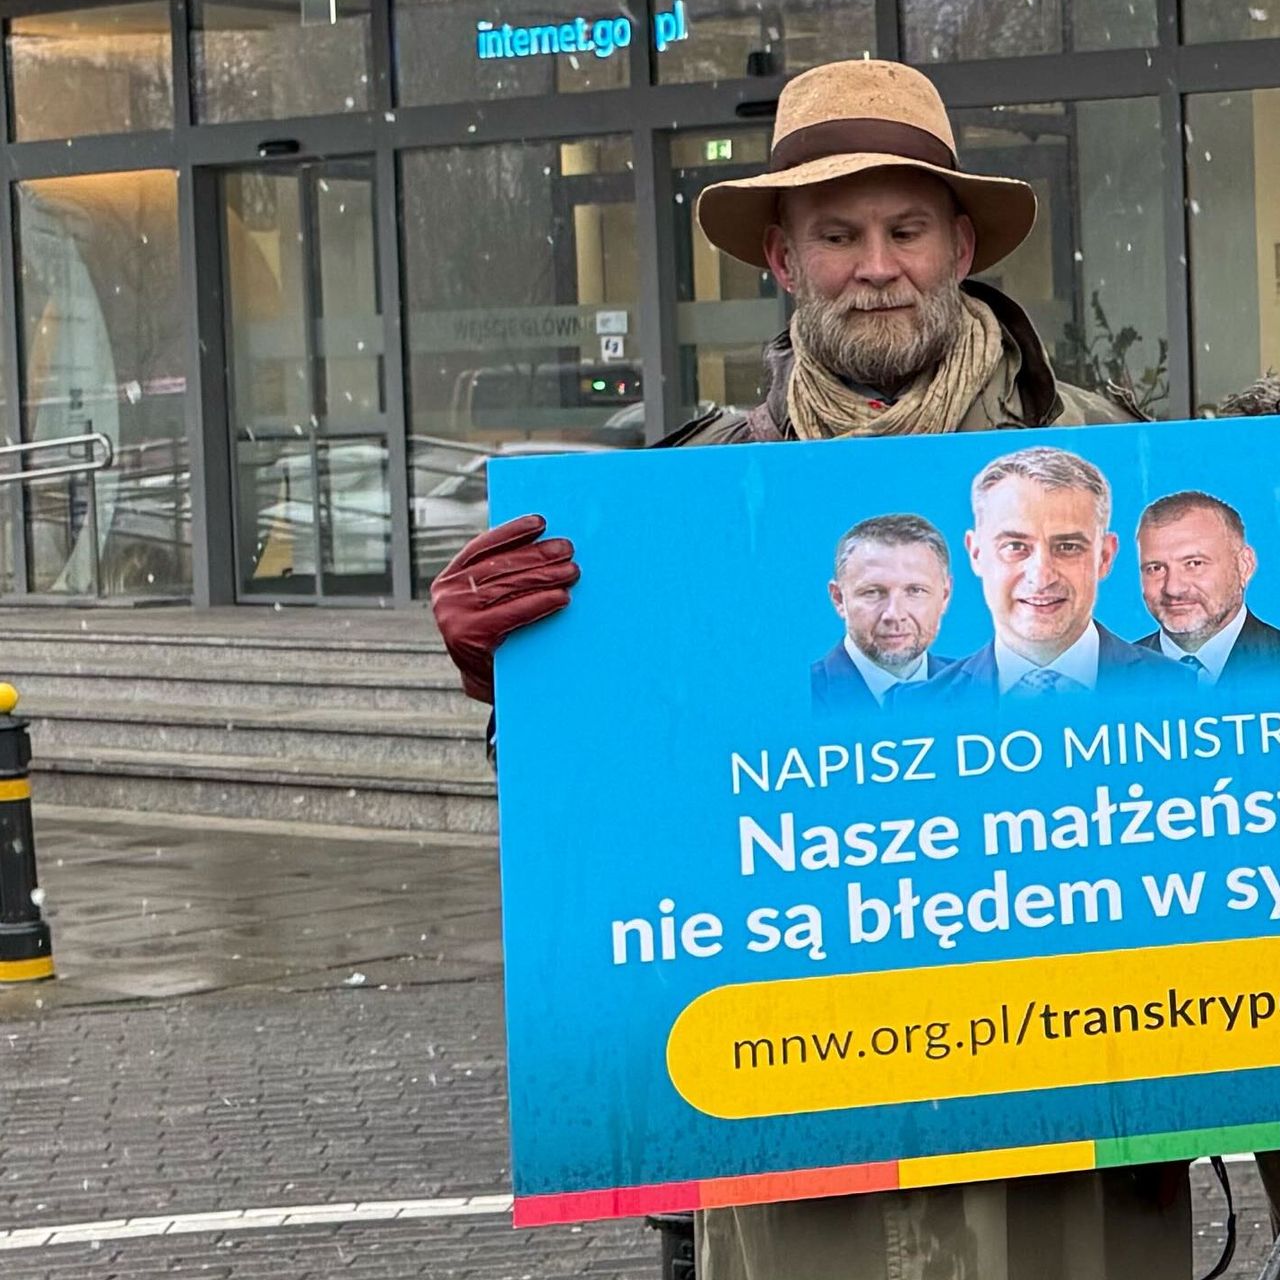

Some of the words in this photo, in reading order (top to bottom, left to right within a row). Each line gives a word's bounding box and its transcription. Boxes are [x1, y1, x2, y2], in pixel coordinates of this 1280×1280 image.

[731, 737, 936, 795] NAPISZ
[956, 730, 1042, 777] DO
[738, 812, 960, 876] Nasze
[611, 897, 723, 965] nie
[746, 904, 827, 961] są
[847, 870, 1123, 950] błędem
[1142, 869, 1206, 917] w
